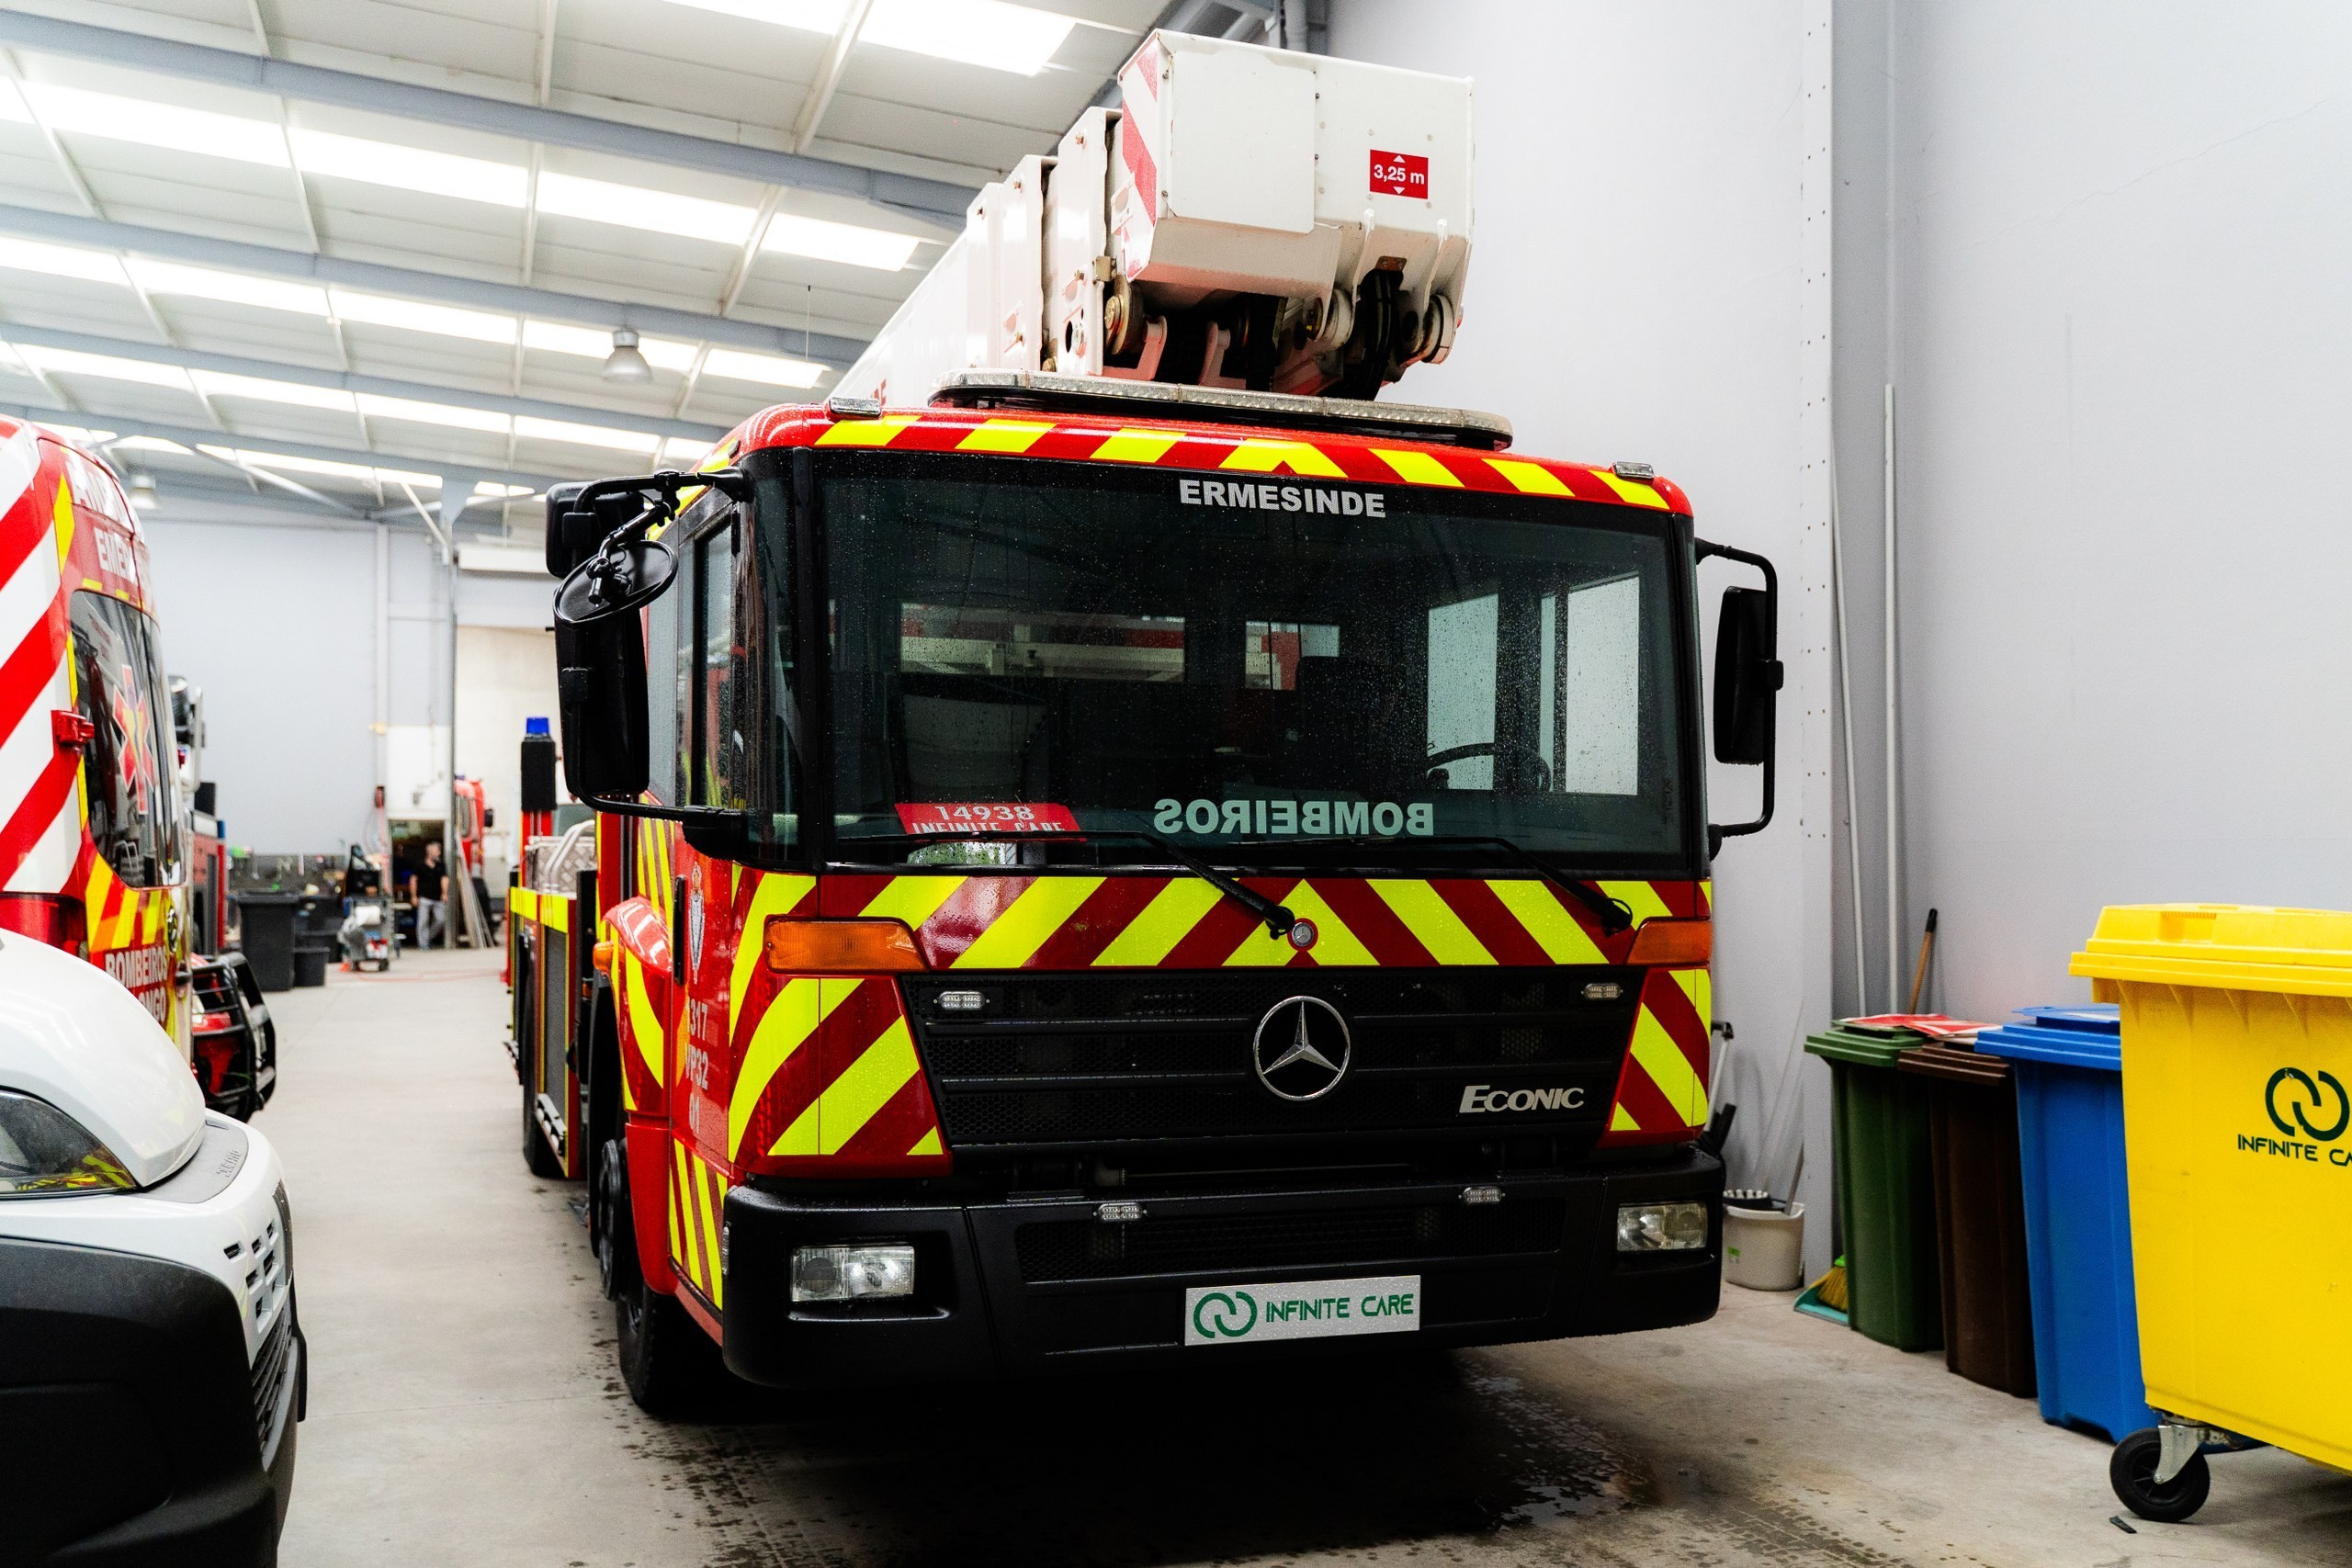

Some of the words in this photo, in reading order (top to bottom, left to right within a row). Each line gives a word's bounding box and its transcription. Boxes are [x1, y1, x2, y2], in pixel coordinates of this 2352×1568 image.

[1373, 164, 1407, 183] 3,25
[1409, 171, 1425, 186] m
[1179, 479, 1386, 518] ERMESINDE
[934, 806, 1035, 820] 14938
[105, 945, 168, 989] BOMBEIROS
[1459, 1085, 1585, 1113] ECONIC
[2237, 1134, 2318, 1162] INFINITE
[1266, 1297, 1351, 1323] INFINITE
[1361, 1293, 1414, 1317] CARE
